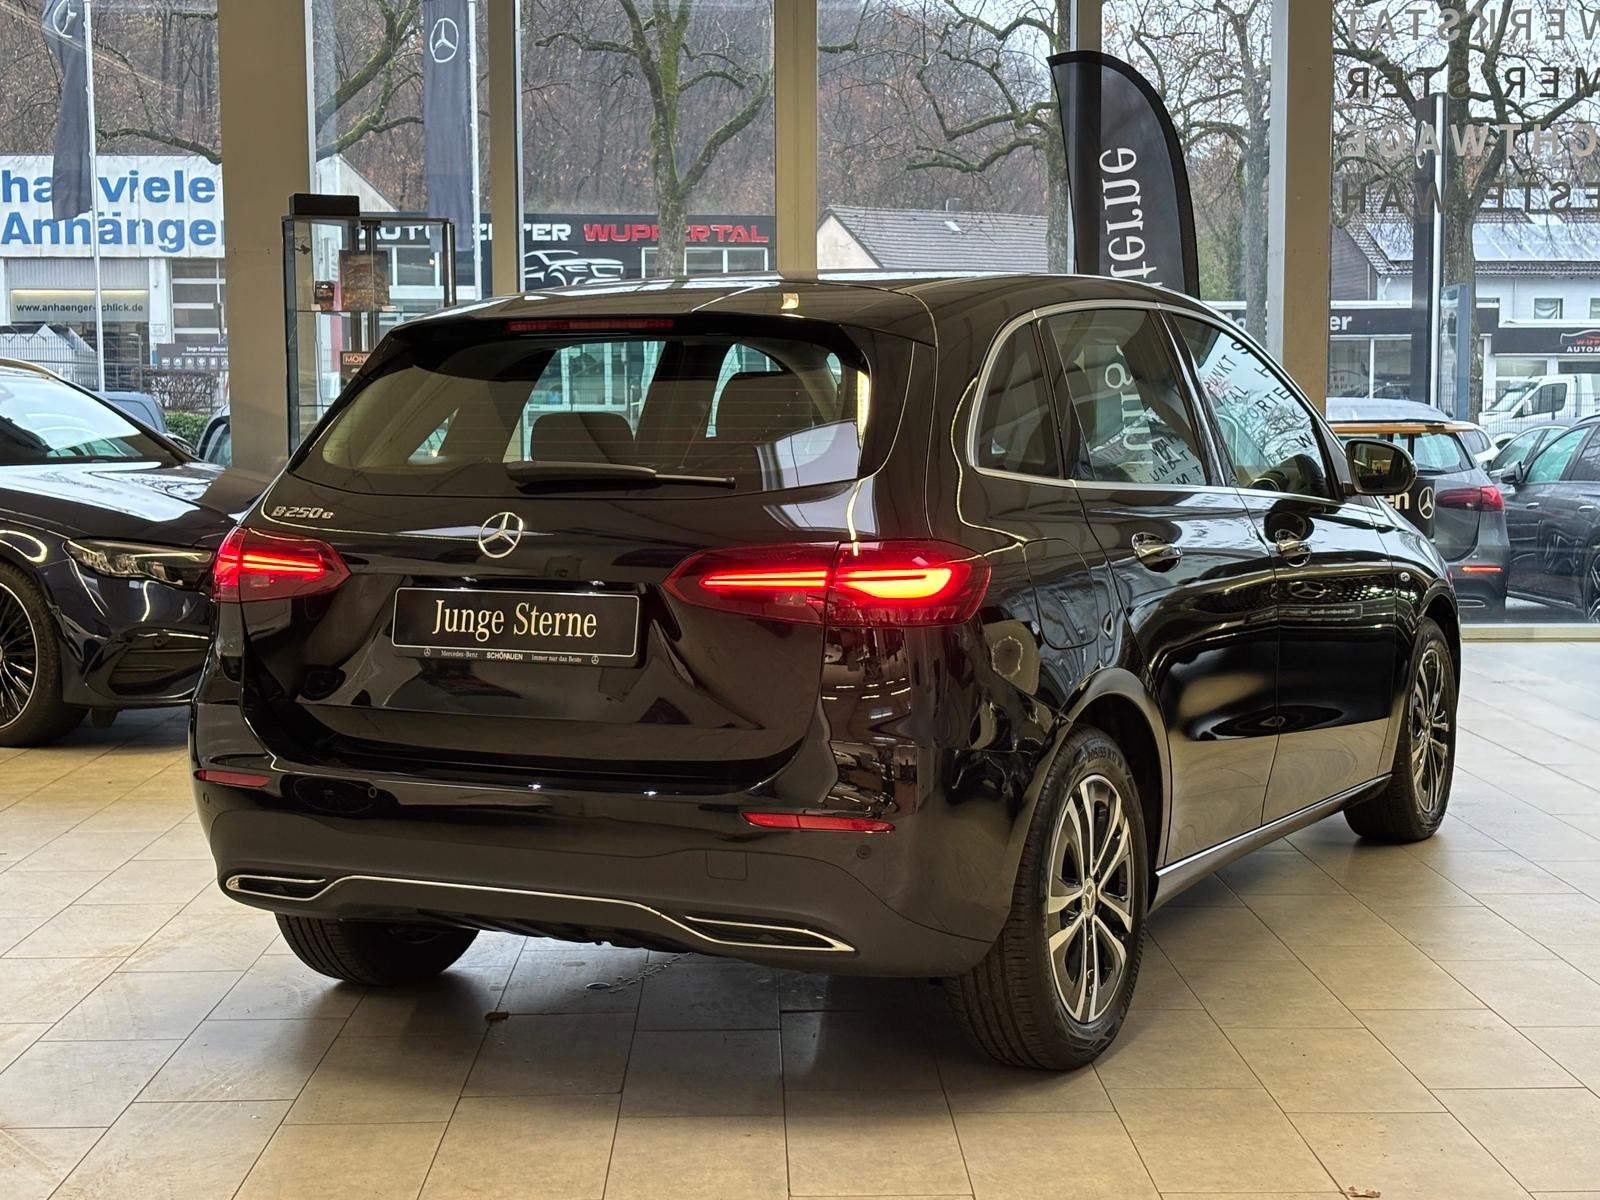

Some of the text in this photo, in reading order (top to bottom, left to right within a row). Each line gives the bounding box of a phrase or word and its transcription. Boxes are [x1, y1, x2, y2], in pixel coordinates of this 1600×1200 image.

[97, 169, 216, 203] viele
[16, 302, 144, 314] www.anhaenger-chlick.de
[431, 599, 598, 643] Junge Sterne
